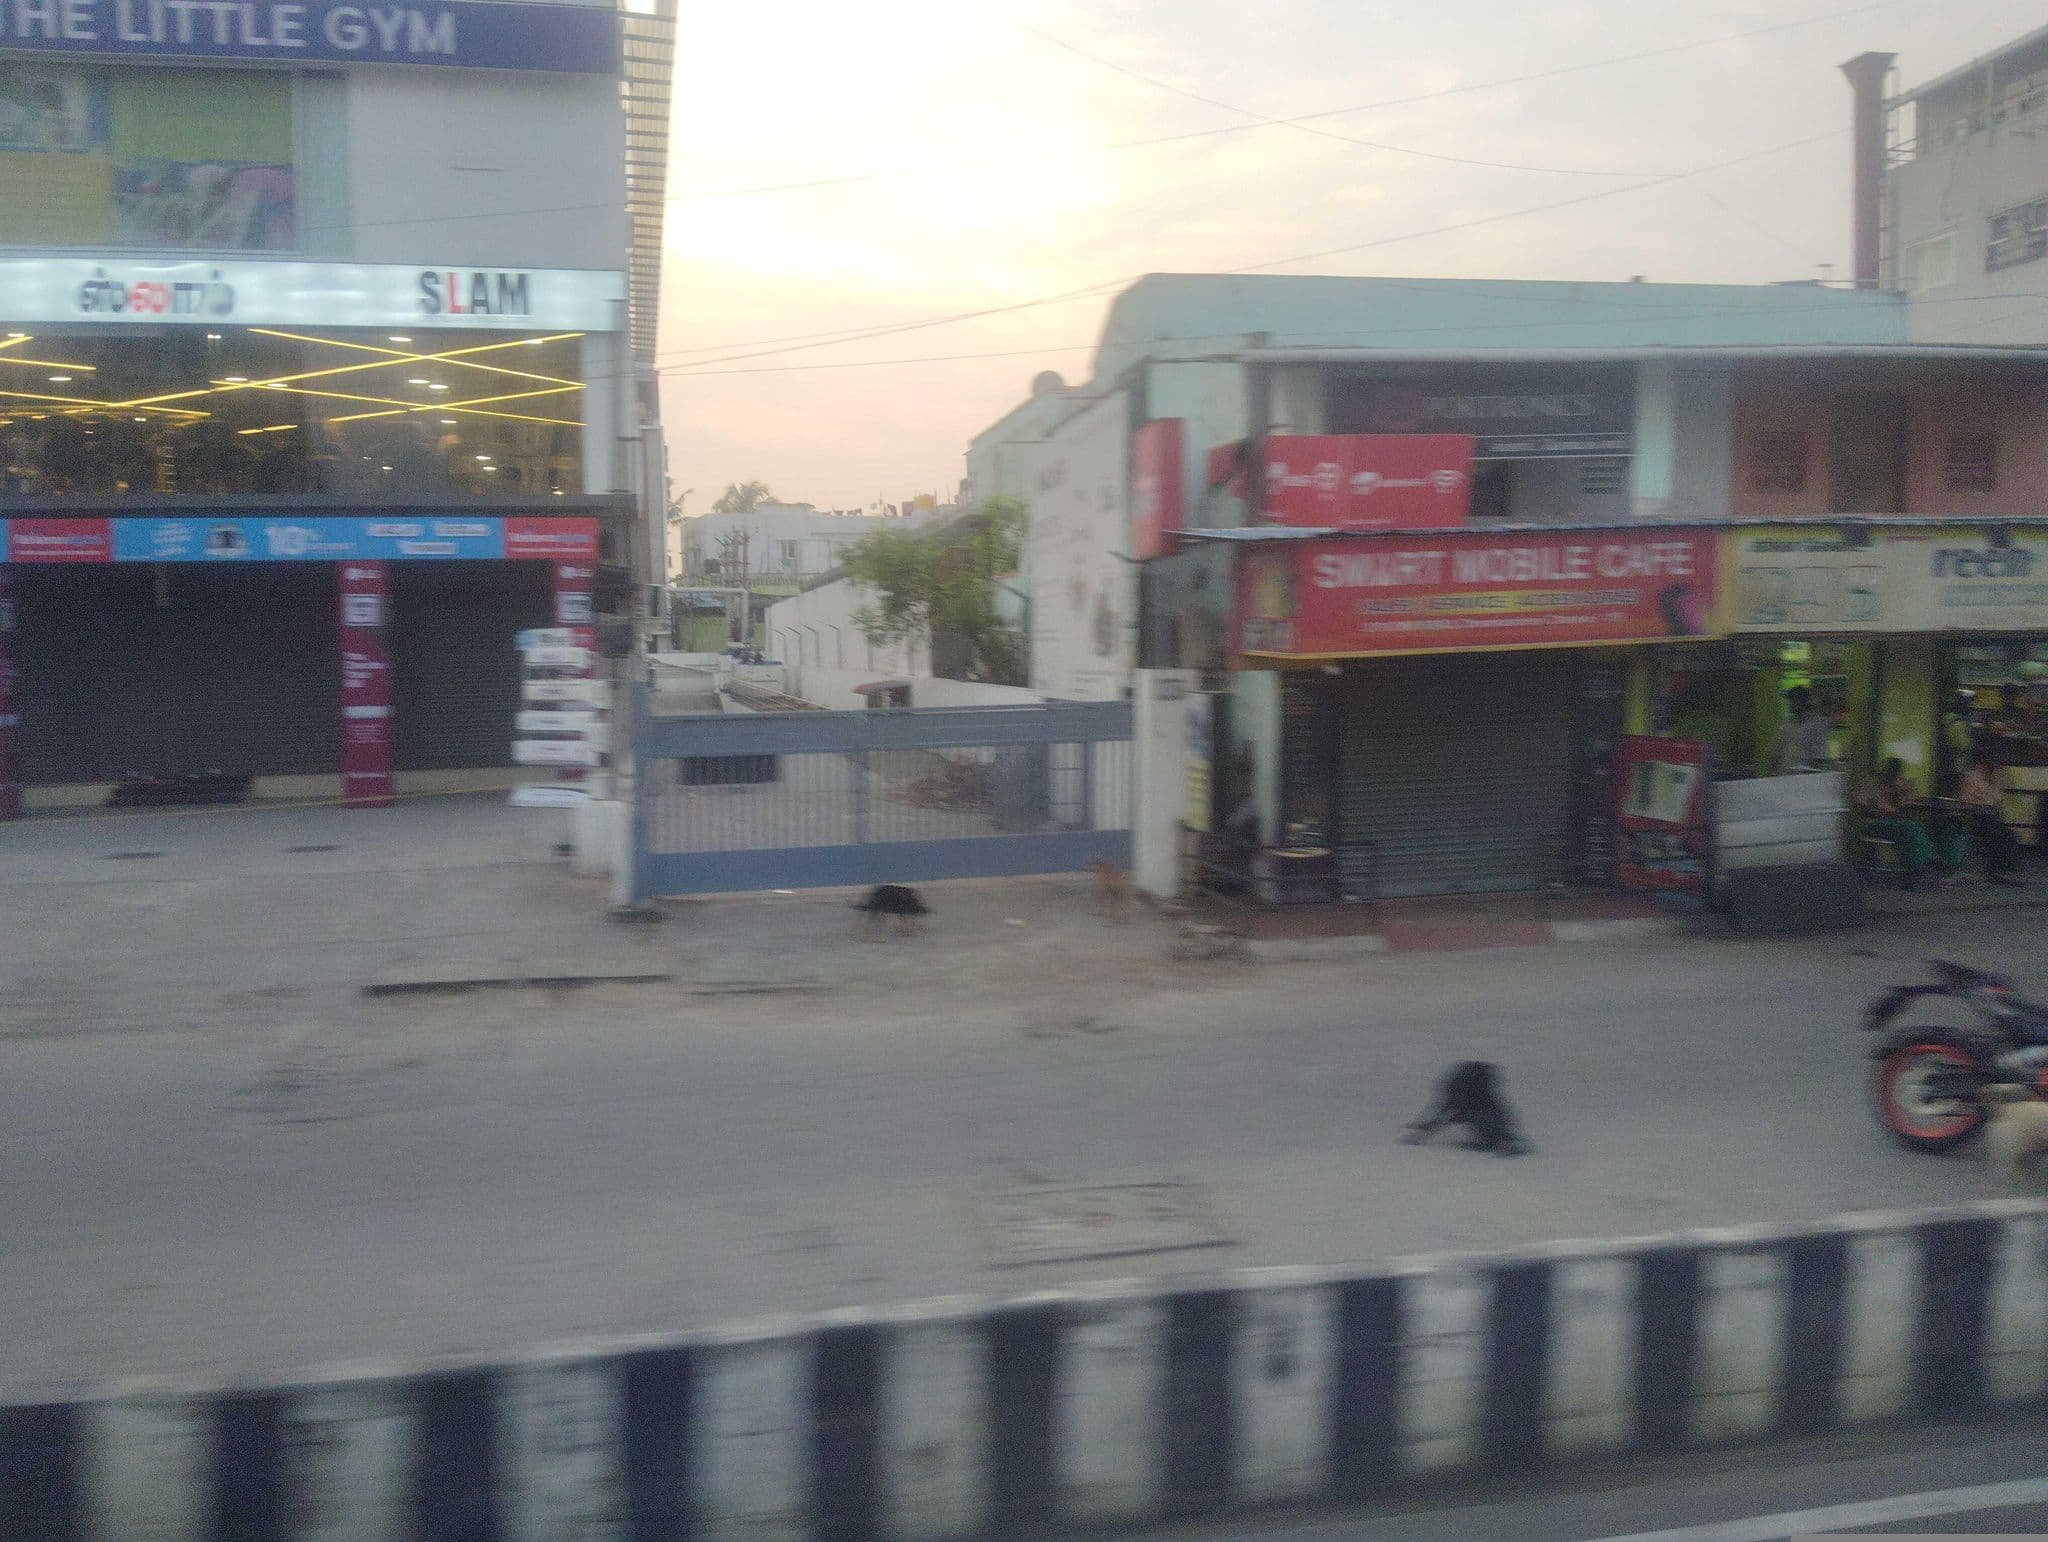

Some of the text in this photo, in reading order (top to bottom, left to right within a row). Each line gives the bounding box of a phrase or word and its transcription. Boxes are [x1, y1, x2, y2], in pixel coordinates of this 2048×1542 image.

[118, 0, 307, 47] LITTLE
[323, 6, 456, 54] GYM
[419, 270, 529, 315] SLAM
[1313, 541, 1695, 588] SMART MOBILE CAFE
